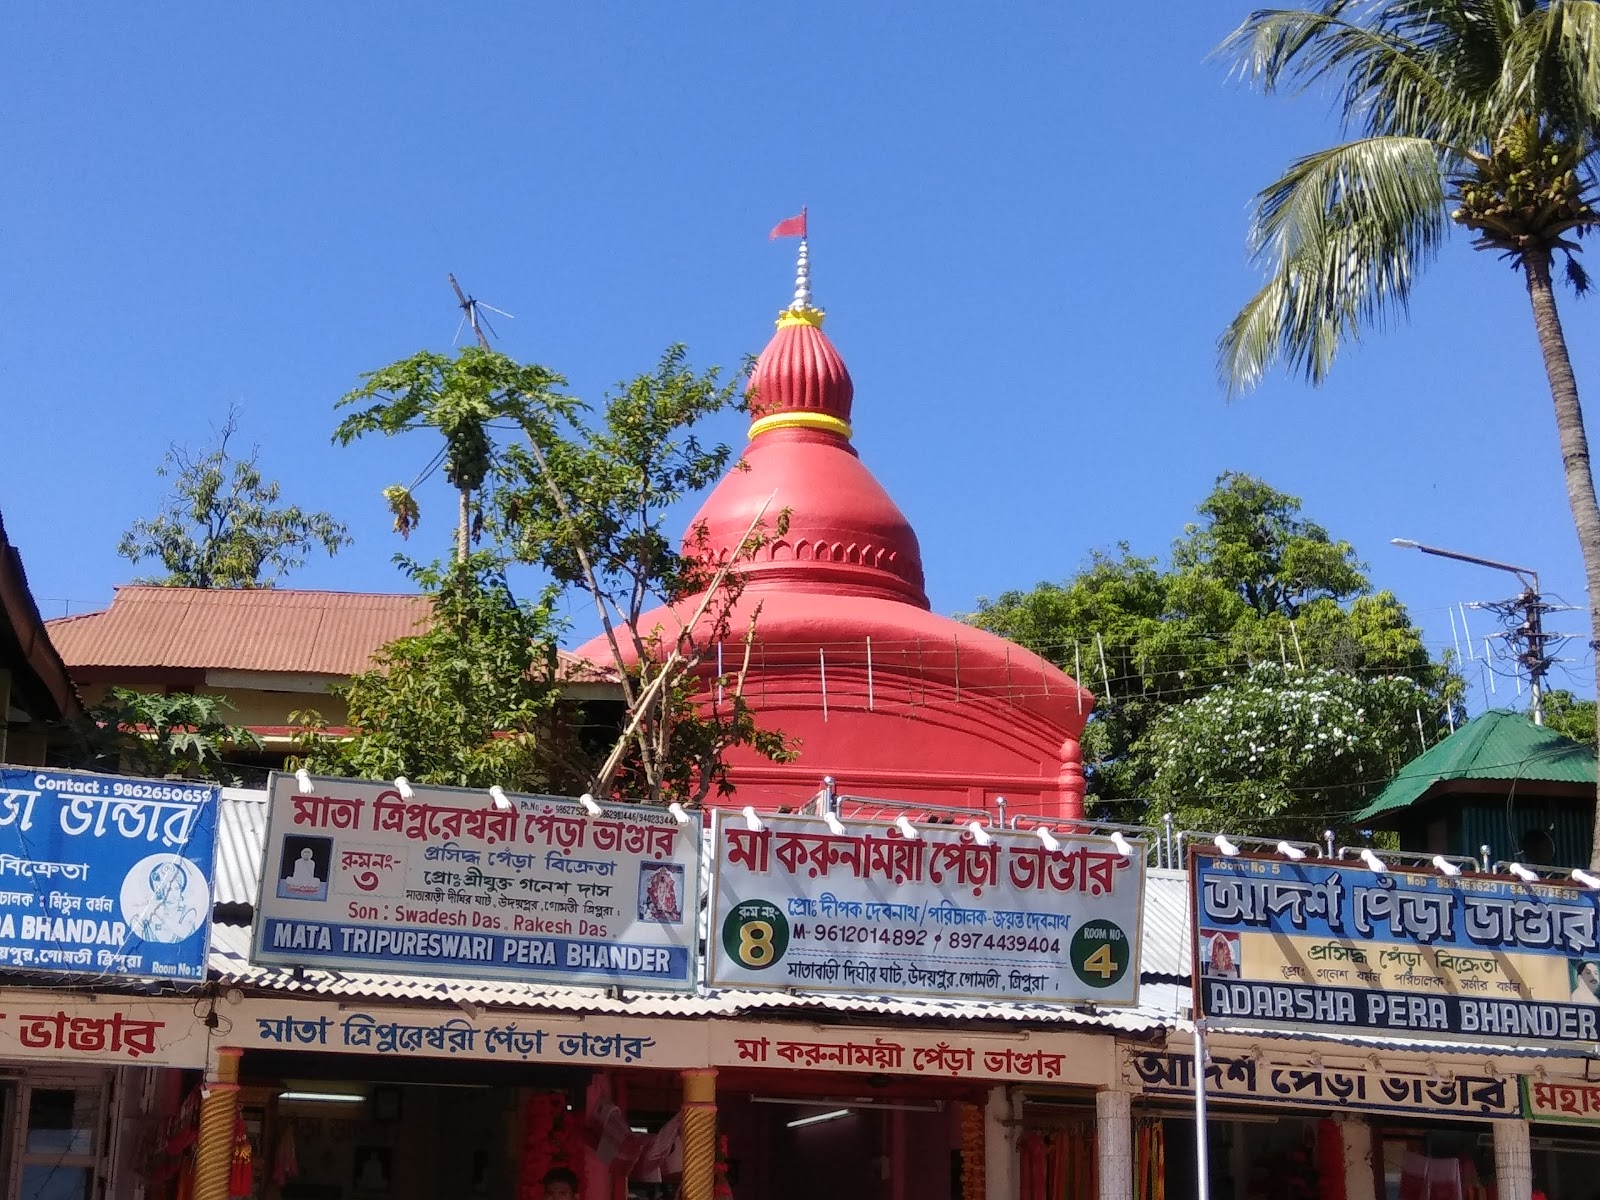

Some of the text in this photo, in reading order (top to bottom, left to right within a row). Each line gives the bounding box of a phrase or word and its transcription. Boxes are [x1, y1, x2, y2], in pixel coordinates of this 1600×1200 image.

[34, 774, 99, 794] Contact
[113, 783, 213, 803] 9862650659
[58, 793, 198, 847] ভান্ডার
[291, 790, 679, 860] মাতা ত্রিপুরেশ্বরী পেঁড়া ভাণ্ডার
[0, 853, 91, 882] বিক্রেতা
[488, 847, 536, 873] পেঁড়া
[544, 850, 618, 877] বিক্রেতা
[725, 827, 773, 872] মা
[929, 831, 1002, 897] পেঁড়া
[353, 871, 379, 891] ৩
[576, 882, 614, 898] দাস
[348, 901, 378, 920] Son
[394, 904, 467, 928] Swadesh
[513, 914, 572, 935] Rakesh
[819, 892, 863, 919] দীপক
[1204, 872, 1343, 928] আদর্শ
[1354, 877, 1454, 942] পেঁড়া
[21, 914, 127, 946] BHANDAR
[814, 924, 928, 947] 9612014892
[949, 932, 1061, 954] 8974439404
[1083, 927, 1107, 940] ROOM
[272, 922, 672, 974] MATA TRIPURESWARI PERA BHANDER
[1083, 943, 1119, 979] 4
[1379, 946, 1423, 970] পেঁড়া
[1435, 949, 1499, 975] বিক্রেতা
[151, 961, 177, 975] Room
[1210, 982, 1599, 1040] ADARSHA PERA BHANDER
[19, 1011, 165, 1058] ভাণ্ডার
[256, 1015, 334, 1046] মাতা
[340, 1013, 481, 1053] ত্রিপুরেশ্বরী
[484, 1021, 550, 1059] পেঁড়া
[734, 1037, 769, 1063] মা
[776, 1037, 905, 1070] করুনাময়ী
[912, 1041, 973, 1076] পেঁড়া
[1133, 1050, 1258, 1092] আদর্শ
